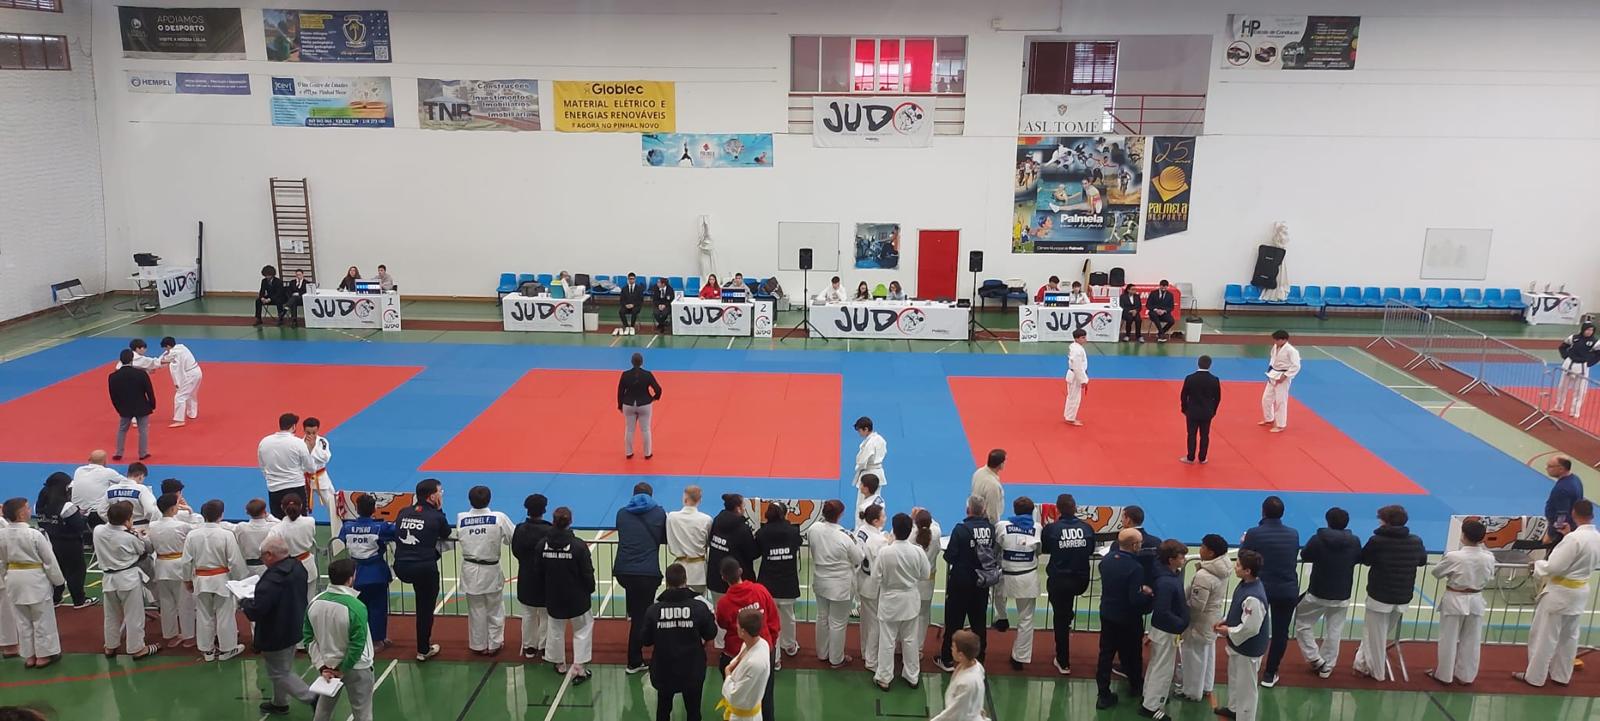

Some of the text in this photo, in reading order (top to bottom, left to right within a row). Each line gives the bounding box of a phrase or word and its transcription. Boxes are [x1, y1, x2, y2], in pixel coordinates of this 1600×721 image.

[157, 16, 204, 24] APOIAMOS
[1241, 20, 1260, 37] HP
[592, 83, 644, 95] Globlec
[563, 99, 666, 108] MATERIAL ELÉTRICO E
[611, 110, 666, 119] RENOVÁVEIS
[1054, 118, 1100, 132] TOMÉ
[1060, 213, 1104, 223] Palmela
[387, 297, 393, 305] 1
[760, 303, 767, 312] 2
[400, 522, 424, 530] JUDO
[973, 527, 991, 539] JUDO
[1061, 528, 1084, 540] JUDO
[712, 535, 727, 545] JUDO
[1059, 539, 1087, 549] BARREIRO
[769, 547, 790, 556] JUDO
[660, 607, 690, 620] JUDO
[657, 620, 693, 629] PINHAL NOVO
